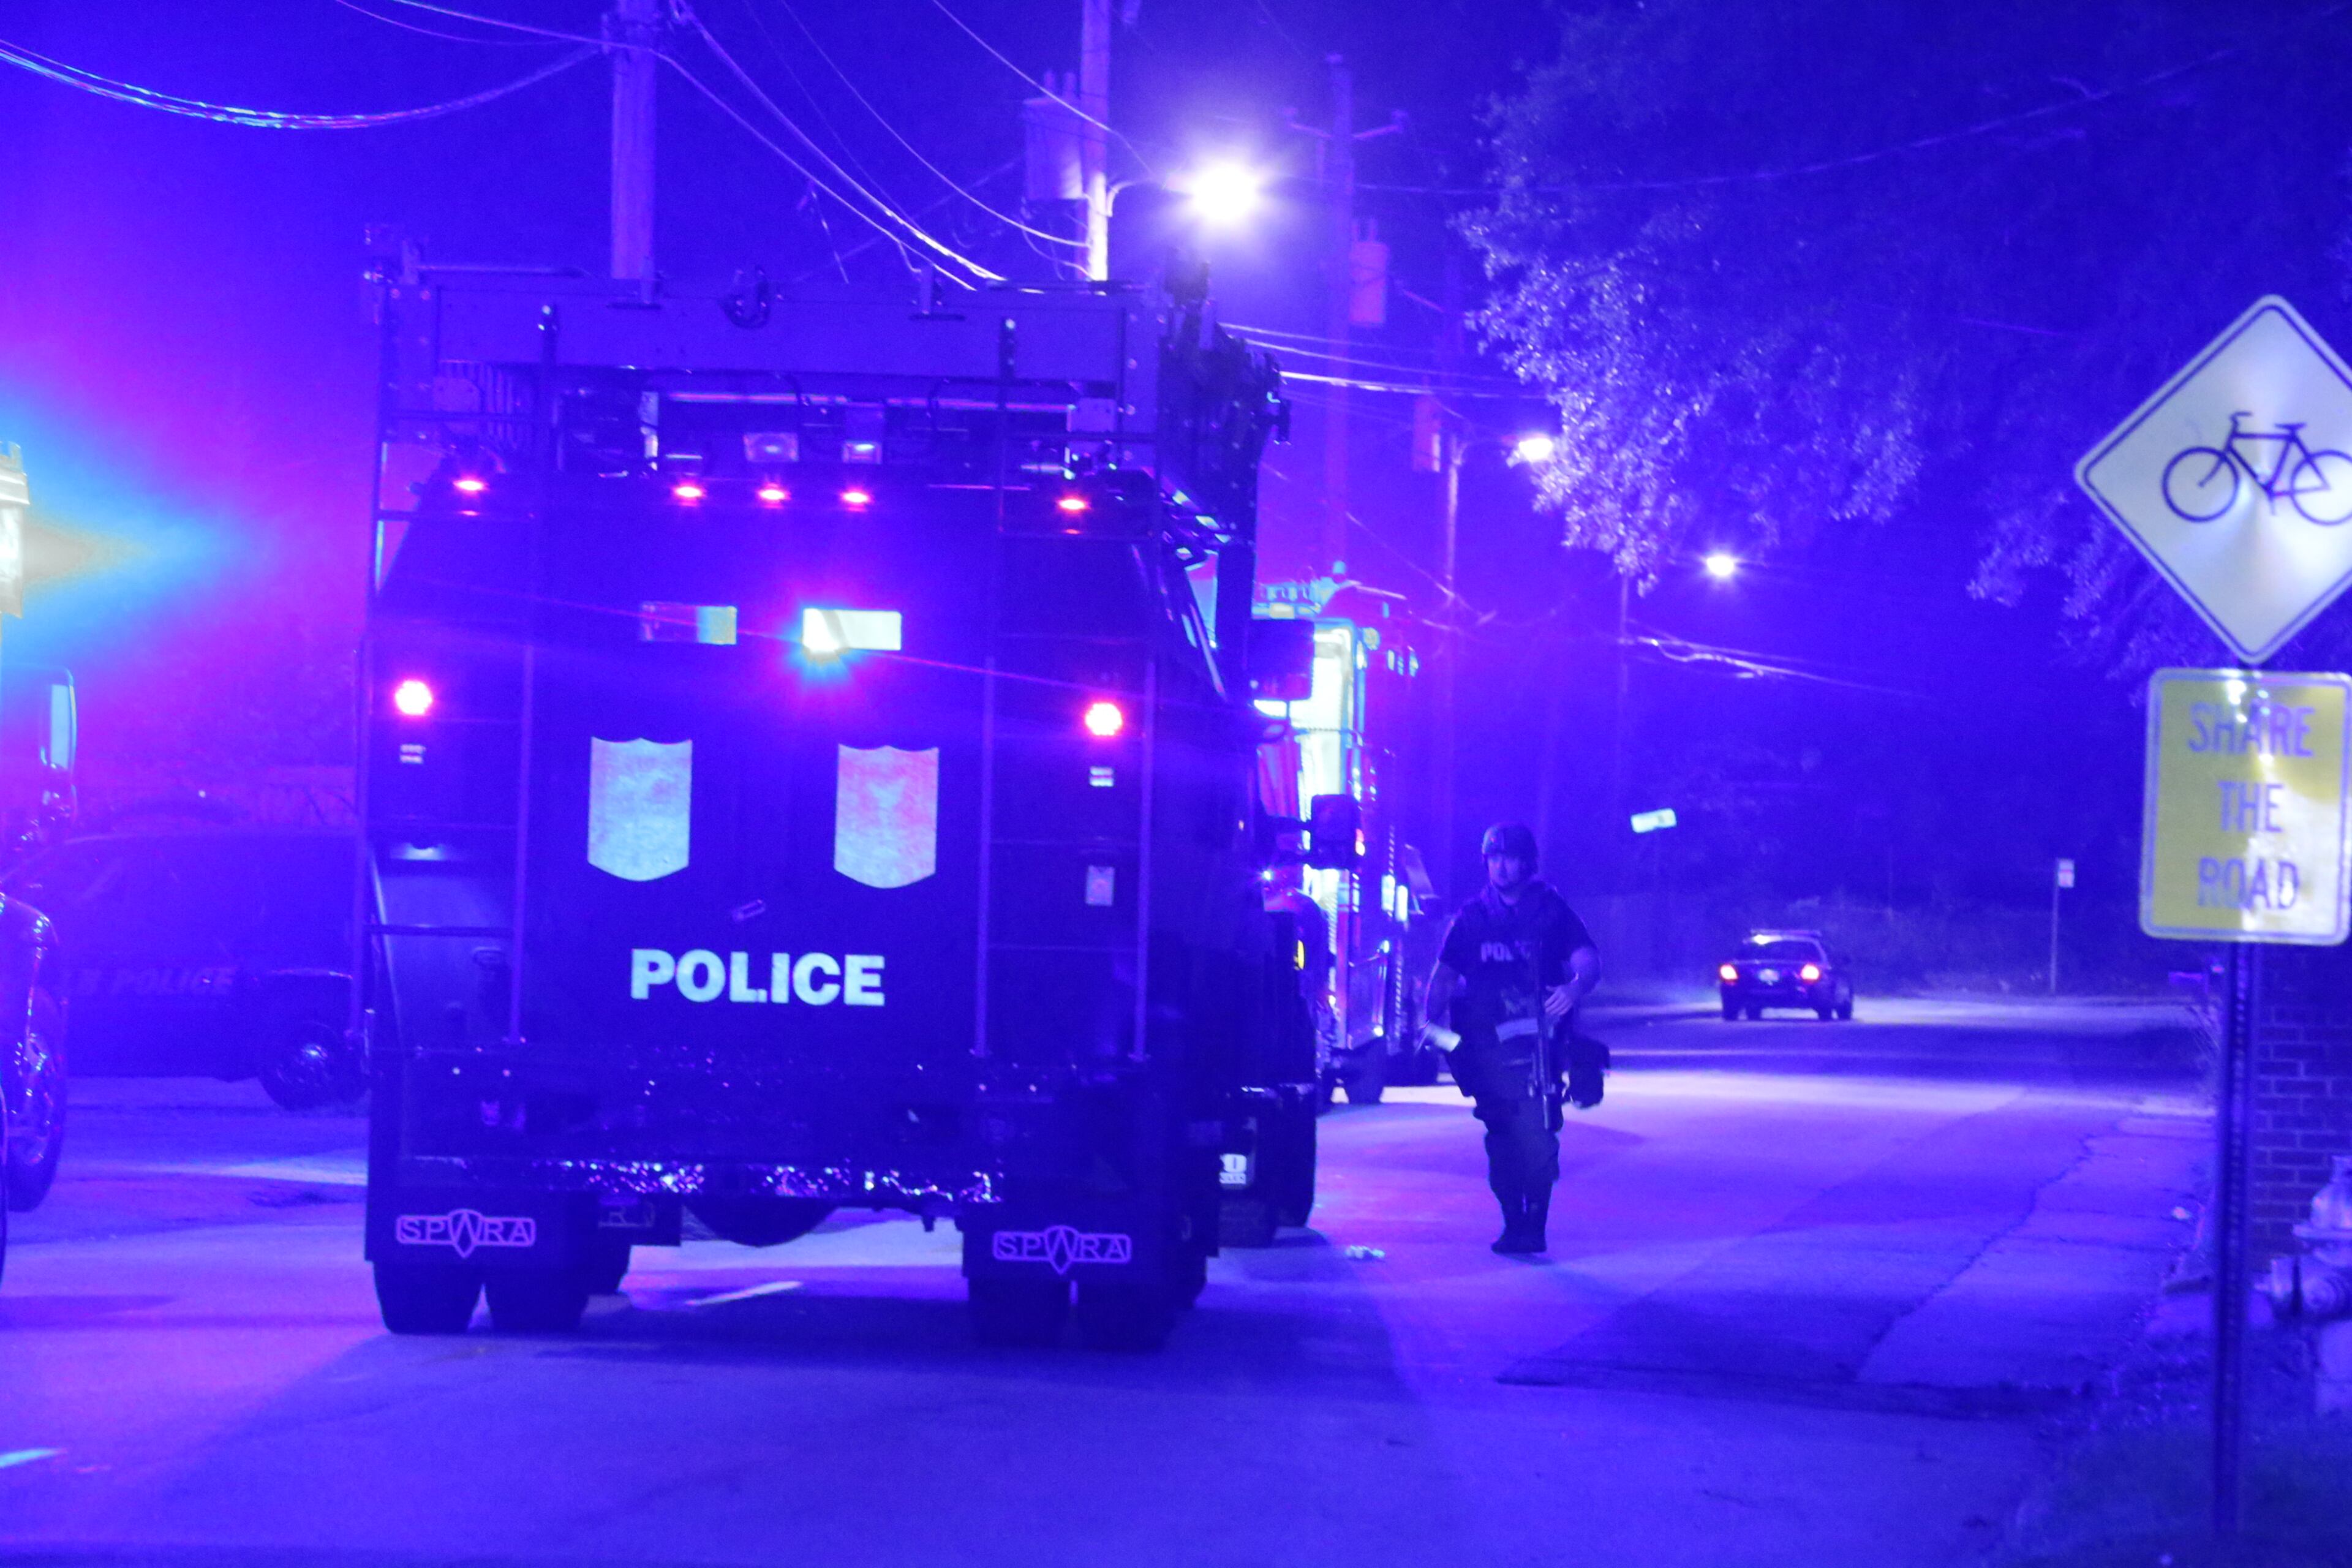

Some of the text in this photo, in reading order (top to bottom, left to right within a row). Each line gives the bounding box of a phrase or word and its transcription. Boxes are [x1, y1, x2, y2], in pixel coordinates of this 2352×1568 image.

[2188, 703, 2315, 756] SHARE
[2217, 780, 2283, 832] THE
[2198, 857, 2300, 909] ROAD
[110, 967, 236, 997] POLICE
[630, 948, 886, 1007] POLICE
